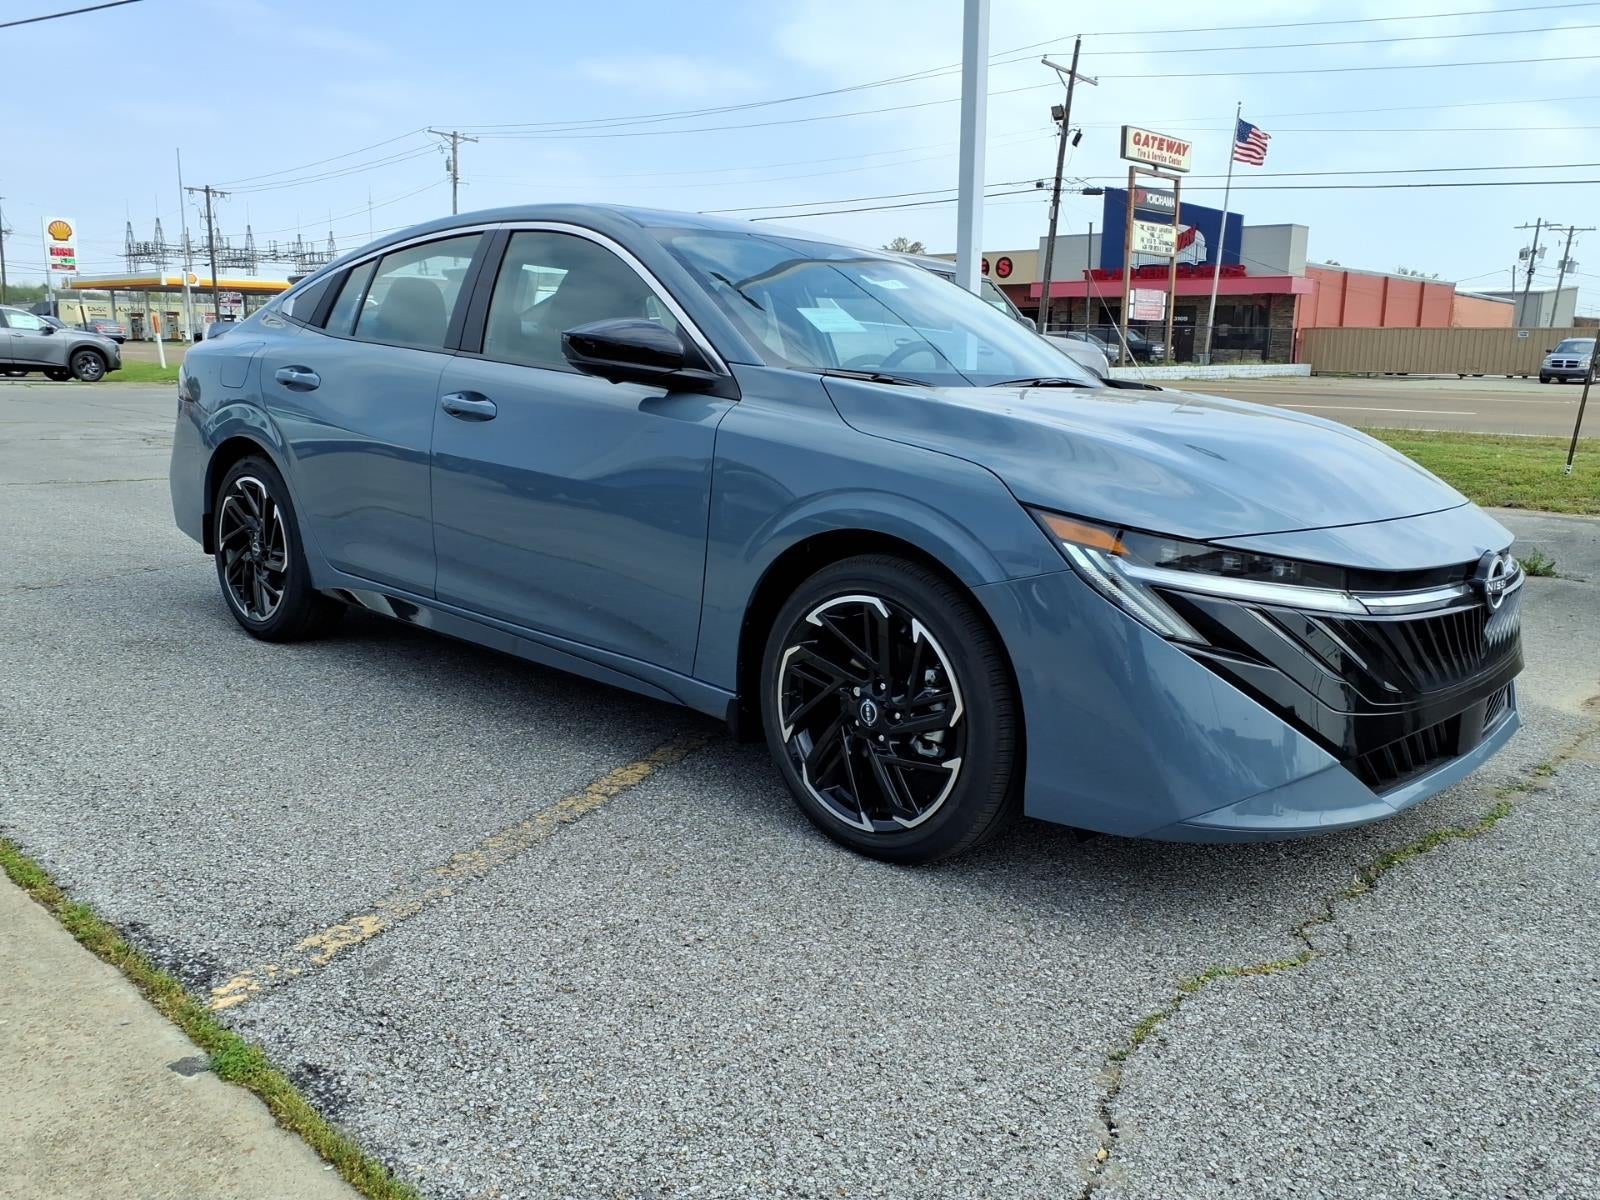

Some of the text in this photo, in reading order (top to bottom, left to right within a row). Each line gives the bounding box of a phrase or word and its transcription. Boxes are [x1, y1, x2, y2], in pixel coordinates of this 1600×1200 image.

[1132, 131, 1190, 157] GATEWAY
[1151, 151, 1167, 163] Service
[1168, 155, 1182, 166] Center
[1146, 192, 1175, 208] YOKOHAMA
